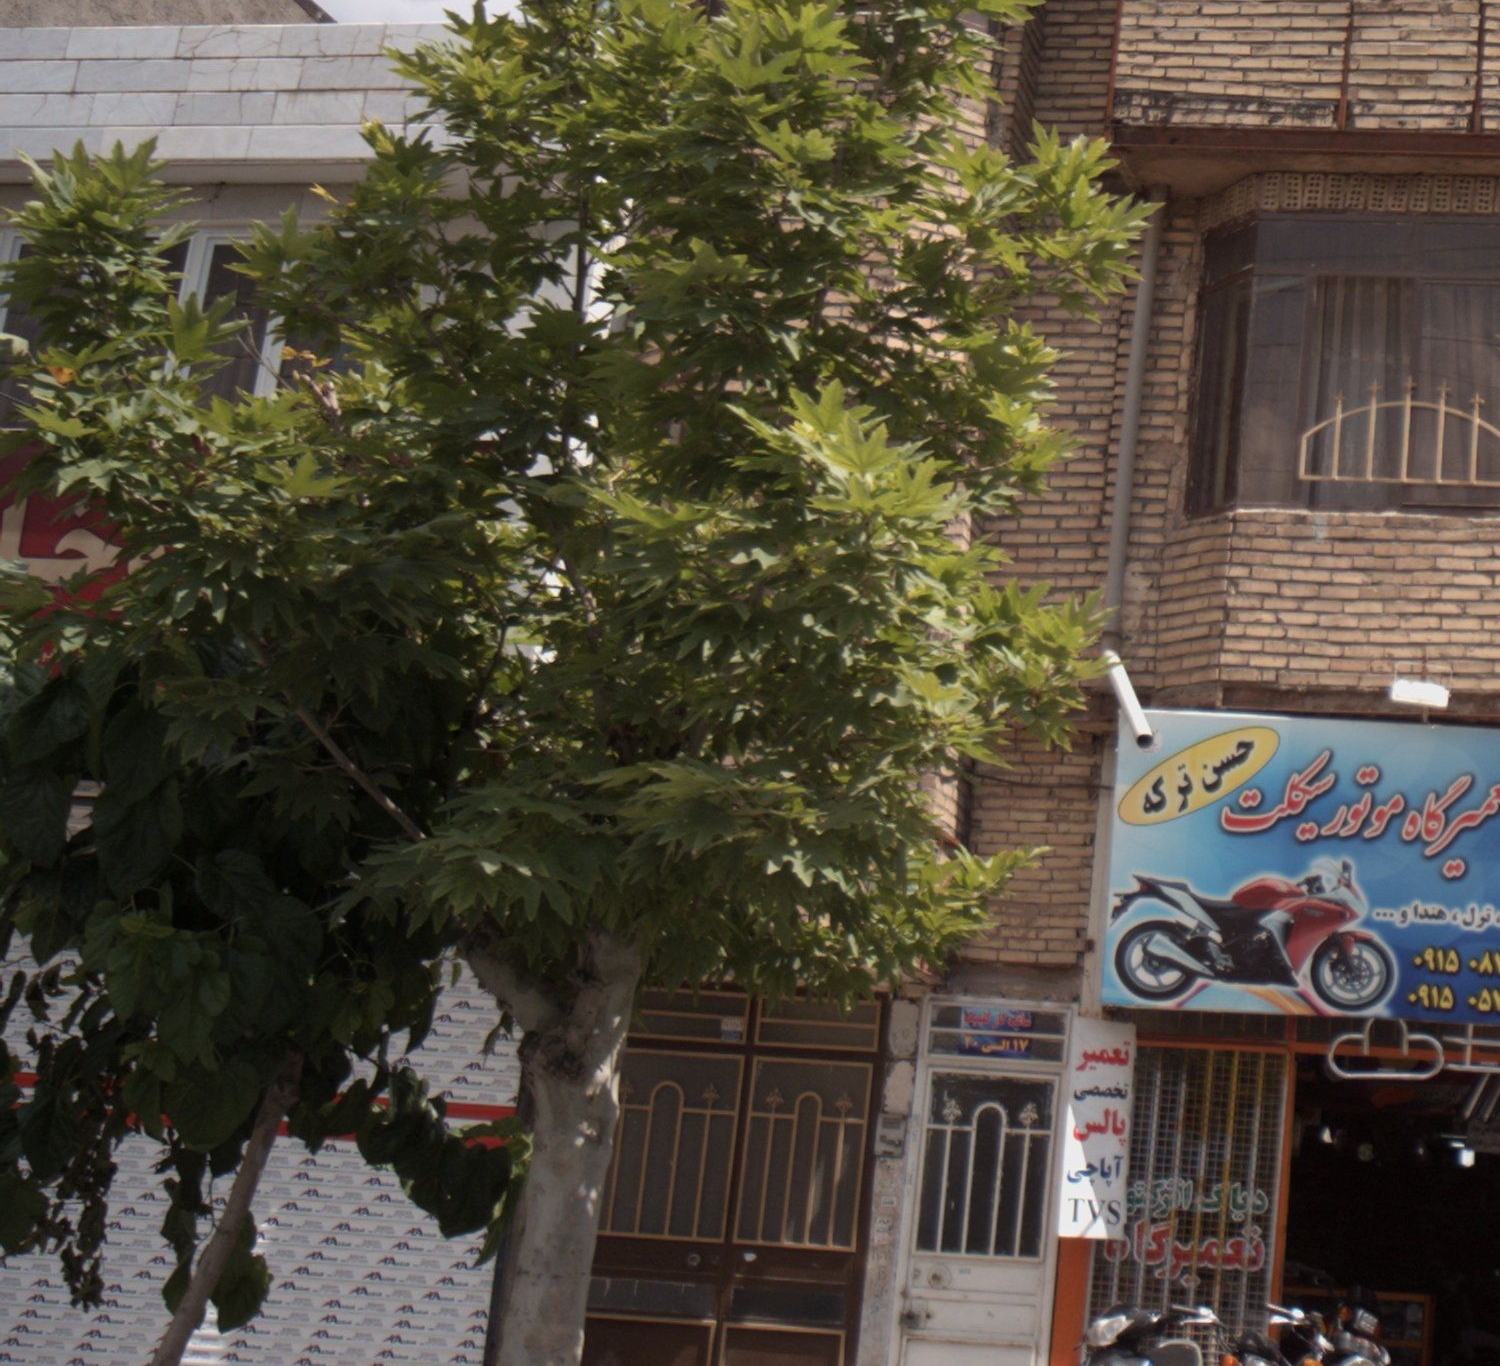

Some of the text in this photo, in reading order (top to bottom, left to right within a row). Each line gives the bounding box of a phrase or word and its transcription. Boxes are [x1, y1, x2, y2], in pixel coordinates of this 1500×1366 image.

[1202, 739, 1255, 793] حسن
[1412, 946, 1461, 974] ۰۹۱۵
[1407, 983, 1455, 1010] ۰۹۱۵
[1075, 1040, 1131, 1072] تعمیر
[1073, 1082, 1129, 1102] تخصصی
[1072, 1107, 1127, 1147] پالس
[1066, 1155, 1125, 1188] آپاچی
[1067, 1197, 1122, 1226] TVS
